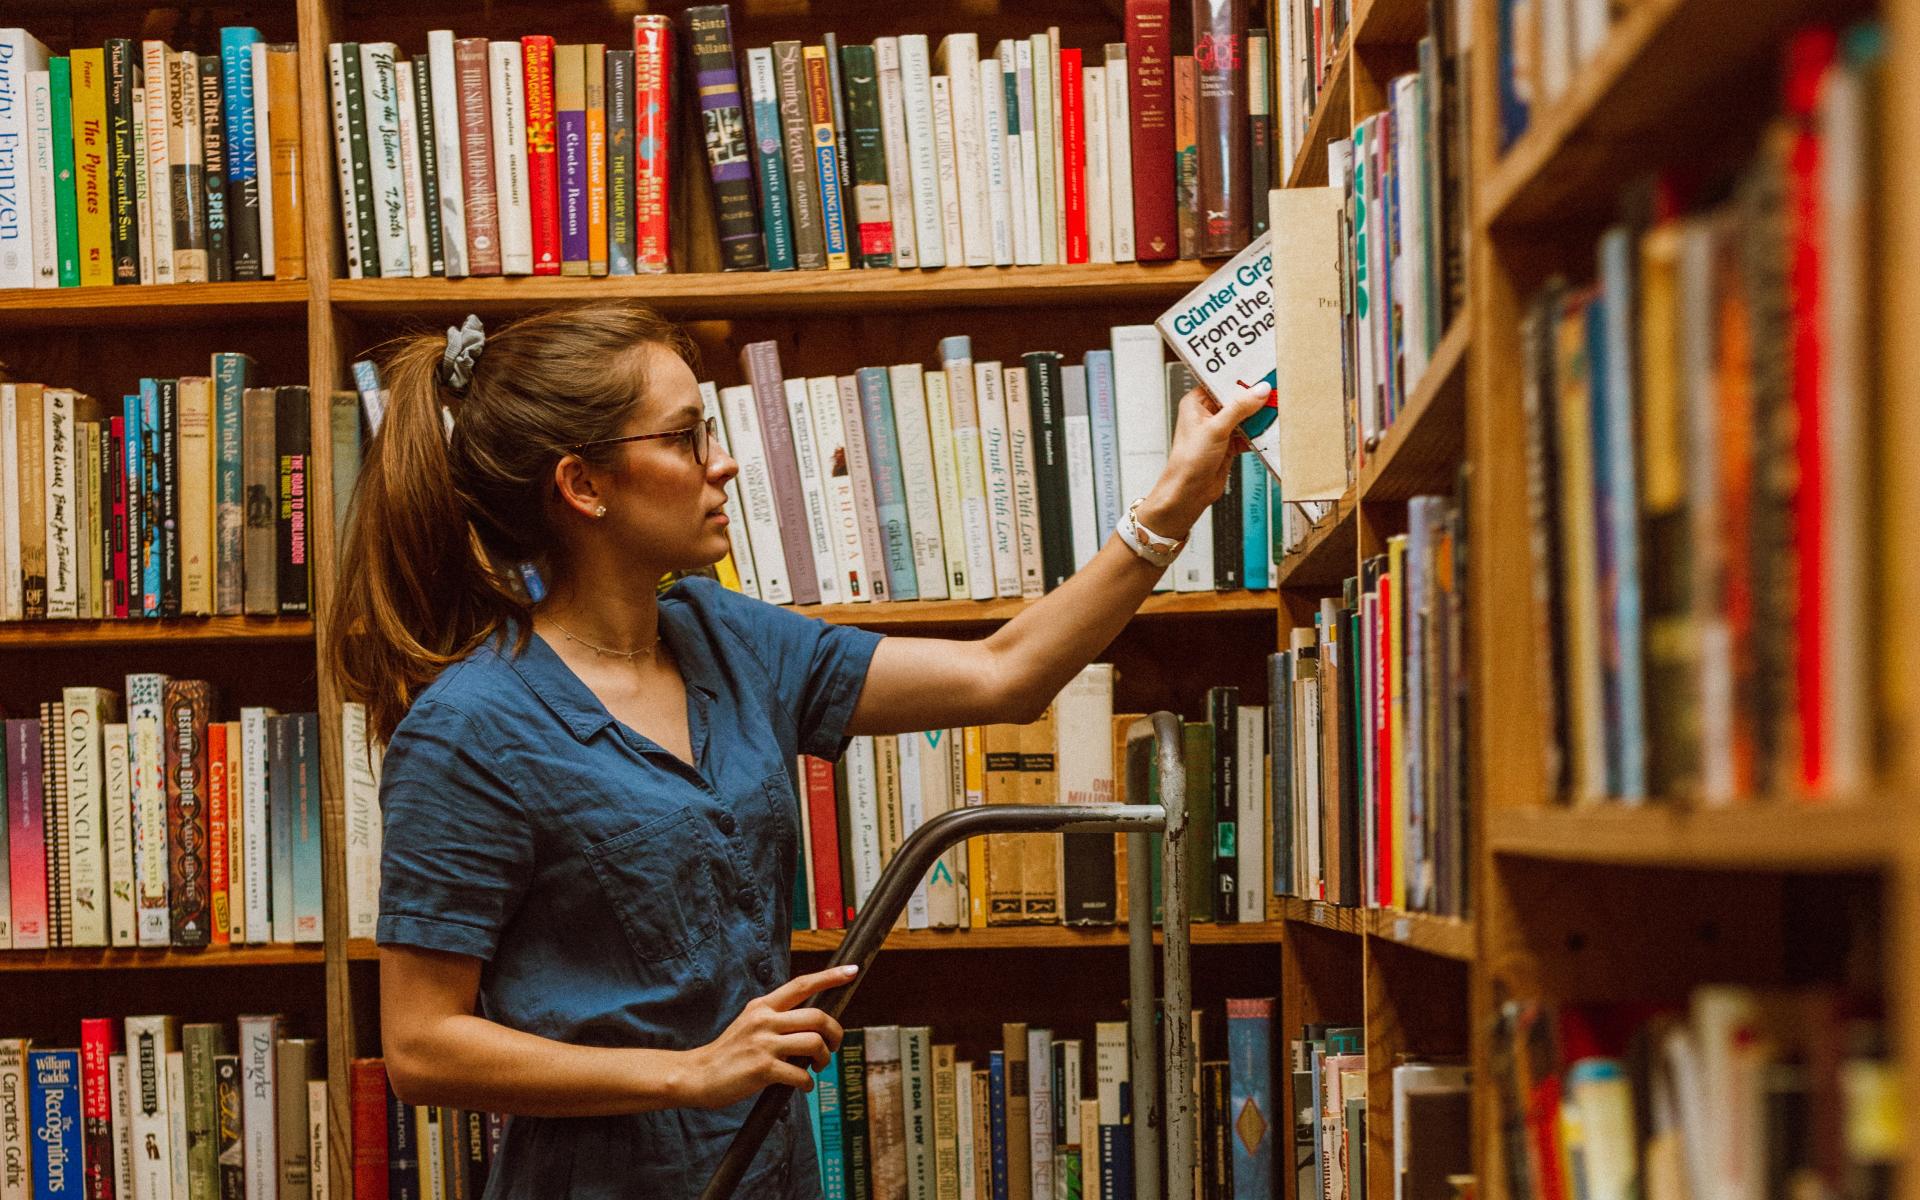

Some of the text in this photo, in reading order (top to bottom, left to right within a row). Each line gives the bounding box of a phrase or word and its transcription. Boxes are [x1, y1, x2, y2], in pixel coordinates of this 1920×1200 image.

[83, 61, 92, 89] Fraser
[111, 45, 123, 104] Michael Frayn
[145, 48, 163, 115] MICHAEL
[170, 62, 183, 129] ENTROPY
[183, 62, 196, 125] AGAINST
[332, 59, 341, 87] THE
[526, 45, 540, 120] CHROMOSOME
[540, 44, 552, 120] THE CALCUTTA
[615, 59, 625, 122] AMITAV GHOSH
[638, 44, 650, 92] GHOSH
[35, 87, 50, 170] Caro Fraser
[226, 45, 240, 175] CHARLES FRAZIER
[239, 45, 258, 208] COLD MOUNTAIN
[336, 101, 346, 144] BOOK
[417, 60, 430, 136] EXTRAORDINARY
[425, 140, 434, 176] PEOPLE
[776, 45, 810, 229] Storming Heaven GIARDINA
[0, 44, 19, 240] Purity Franzen
[82, 119, 100, 214] The Pyrates
[134, 121, 146, 200] THE TIN MEN
[150, 119, 166, 165] FRAYN
[203, 77, 224, 230] MICHAEL FRAYN SPIES
[341, 158, 348, 176] OF
[346, 56, 372, 268] SYLVIE GERMAIN
[566, 133, 578, 175] Circle
[989, 110, 1001, 186] ELLEN FOSTER
[114, 116, 132, 241] A Landing on the Sun
[614, 155, 626, 243] THE HUNGRY TIDE
[820, 149, 841, 250] GOOD KING HARRY
[568, 188, 580, 236] Reason
[1173, 281, 1238, 337] Günter
[1235, 255, 1272, 286] Gra
[1186, 289, 1271, 357] From the
[219, 357, 237, 383] Rip
[1039, 363, 1050, 386] ELLEN
[1205, 351, 1226, 374] of
[1229, 340, 1242, 357] a
[223, 384, 238, 410] Van
[1042, 387, 1052, 424] GILCHRIST
[1097, 362, 1109, 421] GILCHRIST
[223, 412, 239, 463] Winkle
[902, 405, 922, 457] ANNA
[280, 455, 291, 473] FRITZ
[291, 455, 303, 471] THE
[292, 473, 303, 495] ROAD
[985, 369, 1011, 554] Gilchrist Drunk With Love
[1009, 370, 1036, 556] Gilchrist Drunk With Love
[1101, 443, 1115, 509] DANGEROUS
[292, 497, 303, 509] TO
[910, 463, 930, 521] PAPERS
[1106, 511, 1117, 531] AGE
[837, 486, 860, 561] RHODA
[887, 519, 905, 572] Gilchrist
[914, 531, 927, 567] Gilchrist
[927, 537, 937, 559] Ellen
[70, 709, 91, 856] CONSTANCIA
[110, 744, 128, 854] CONSTANCIA
[953, 744, 961, 796] ELPENOR
[1068, 790, 1113, 803] MILLION
[1093, 778, 1114, 792] ONE
[177, 709, 196, 897] DESTINY AND DESIRE CARLOS FUENTES
[211, 761, 225, 884] CARLOS FUENTES
[245, 717, 259, 910] The Crystal Frontier CARLOS FUENTES
[145, 799, 158, 890] CARLOS FUENTES
[215, 896, 229, 929] USED
[36, 1055, 71, 1072] William
[38, 1070, 69, 1084] Gaddis
[140, 1040, 156, 1110] METROPOLIS
[245, 1033, 271, 1100] Dangler
[909, 1035, 919, 1071] YEARS
[86, 1041, 96, 1134] ARE SAFEST
[95, 1040, 107, 1136] JUST WHEN WE
[119, 1090, 127, 1117] Gadol
[819, 1081, 838, 1113] ANNA
[843, 1046, 864, 1121] THE GROWN UPS
[911, 1077, 921, 1110] FROM
[3, 1073, 25, 1188] Carpenter's Gothic
[38, 1089, 69, 1192] Recognitions
[62, 1116, 73, 1132] The
[121, 1127, 129, 1145] THE
[470, 1112, 482, 1163] CEMENT
[914, 1116, 923, 1145] NOW
[121, 1148, 130, 1191] MYSTERY
